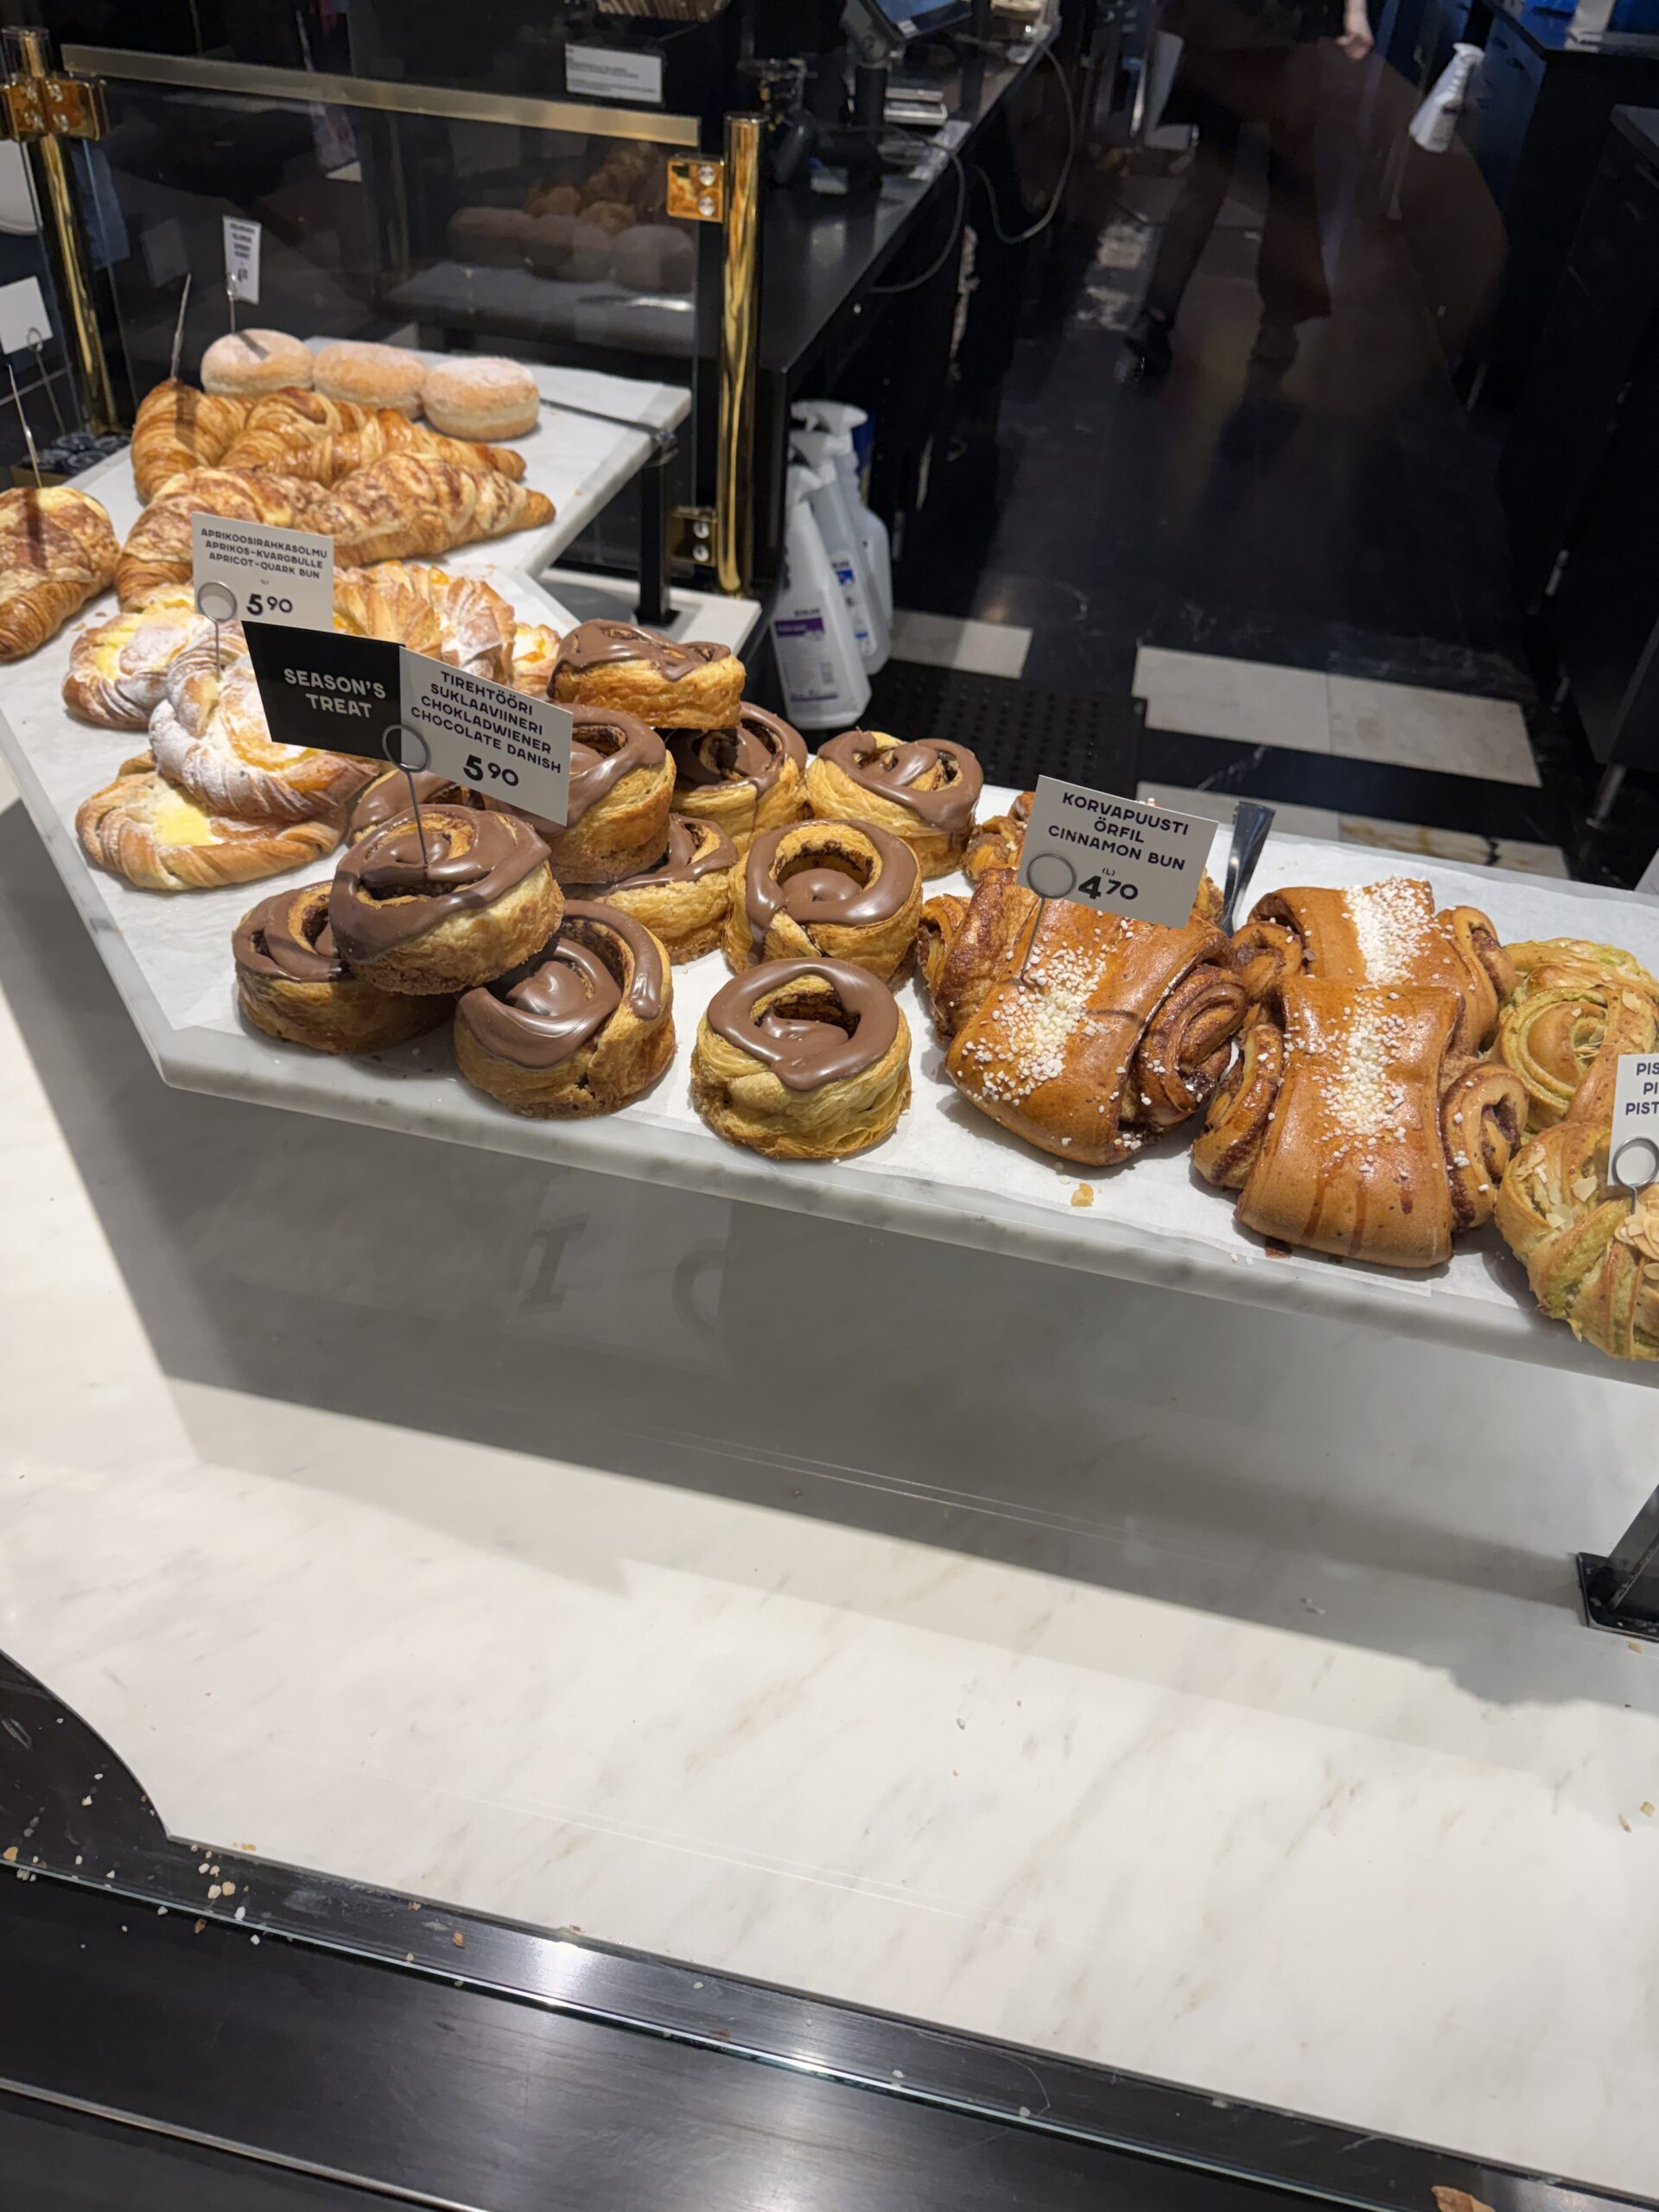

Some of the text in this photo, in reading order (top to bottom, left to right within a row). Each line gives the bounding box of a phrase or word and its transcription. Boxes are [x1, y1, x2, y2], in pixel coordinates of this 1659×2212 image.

[201, 528, 327, 558] APRIKOOSIRAHKASOLMU
[206, 540, 323, 569] APRIKOS-KVARGBULLE
[209, 552, 320, 579] APRICOT-QUARK BUN
[283, 668, 386, 699] SEASON'S
[441, 671, 532, 715] TIREHTÖÖRI
[305, 693, 372, 718] TREAT
[430, 683, 543, 735] SUKLAAVIINERI
[411, 707, 561, 773] CHOCOLATE DANISH
[421, 696, 551, 754] CHOKLADWIENER
[1063, 792, 1189, 836] KORVAPUUSTI
[1094, 817, 1145, 843] ÖRFIL
[1048, 825, 1185, 871] CINNAMON BUN
[1625, 1101, 1659, 1116] PIST
